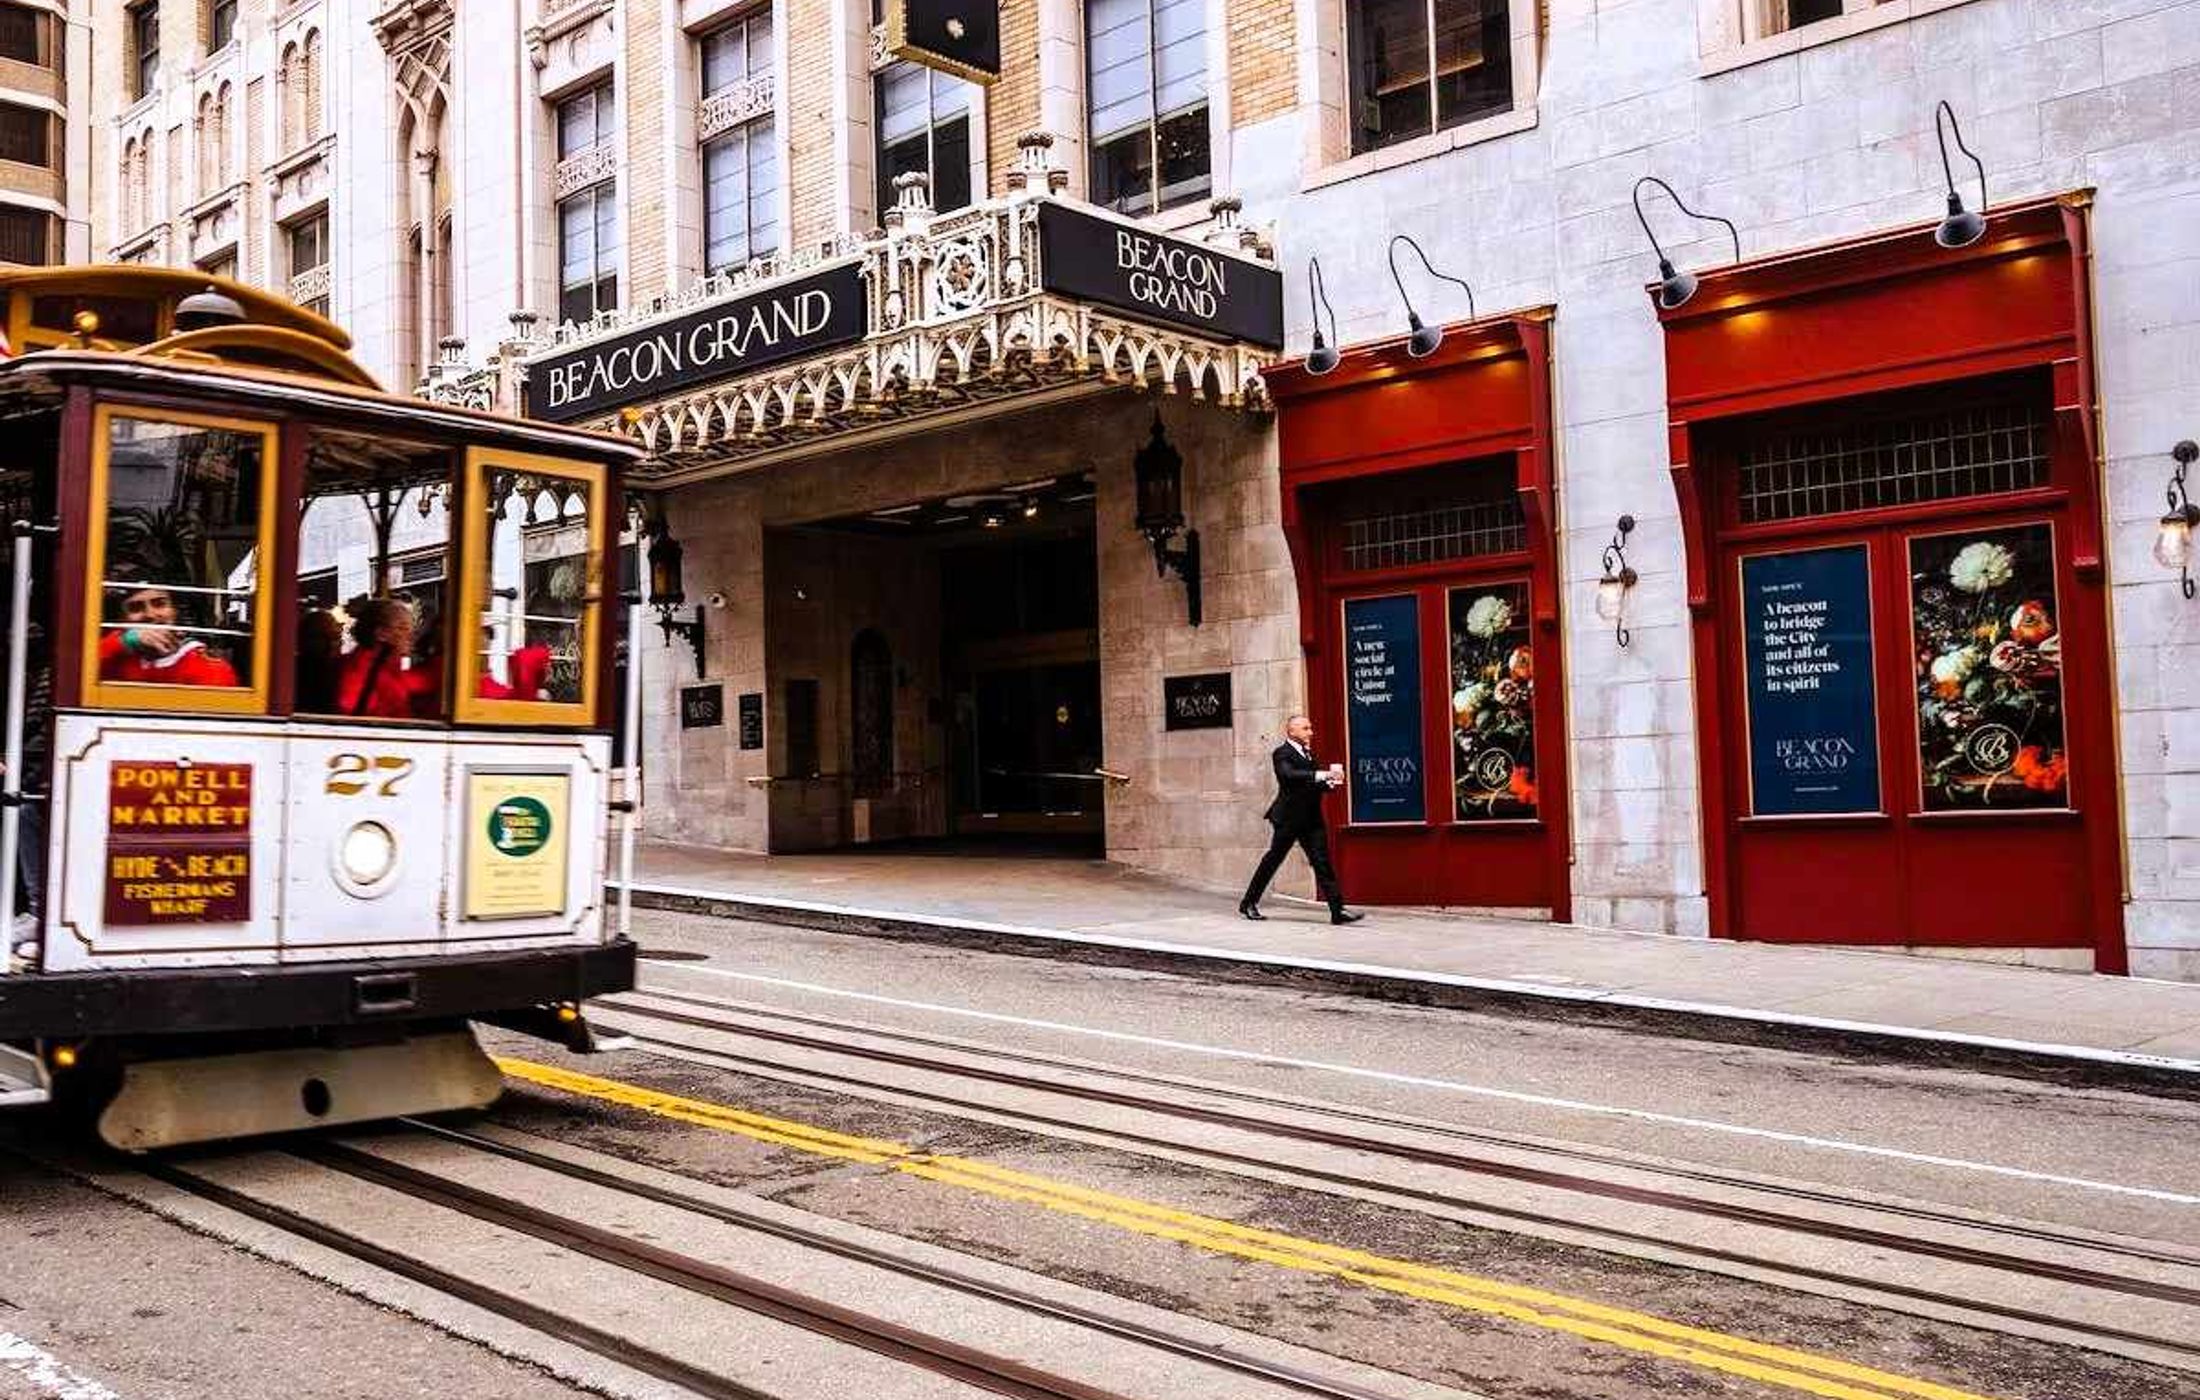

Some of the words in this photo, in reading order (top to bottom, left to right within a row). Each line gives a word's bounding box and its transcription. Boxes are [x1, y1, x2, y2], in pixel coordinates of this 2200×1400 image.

[1117, 230, 1226, 296] BEACON
[1129, 272, 1217, 319] GRAND
[548, 331, 682, 408] BEACON
[688, 290, 832, 366] GRAND
[1776, 600, 1828, 615] beacon
[1764, 620, 1779, 631] to
[1780, 615, 1825, 631] bridge
[1765, 633, 1787, 646] the
[1789, 631, 1819, 644] City
[1354, 652, 1385, 664] social
[1765, 647, 1792, 661] and
[1794, 644, 1813, 659] all
[1814, 643, 1832, 657] of
[1354, 665, 1383, 679] circle
[1766, 663, 1784, 677] its
[1785, 661, 1840, 675] citizens
[1354, 679, 1386, 691] Union
[1767, 679, 1781, 692] in
[1782, 676, 1821, 693] spirit
[1353, 692, 1393, 706] Square
[1776, 738, 1855, 757] BEACON
[1358, 757, 1417, 773] BEACON
[1784, 754, 1848, 770] GRAND
[117, 768, 247, 789] POWELL
[325, 753, 413, 797] 27
[1365, 771, 1412, 785] GRAND
[152, 790, 217, 805] AND
[112, 805, 249, 825] MARKET
